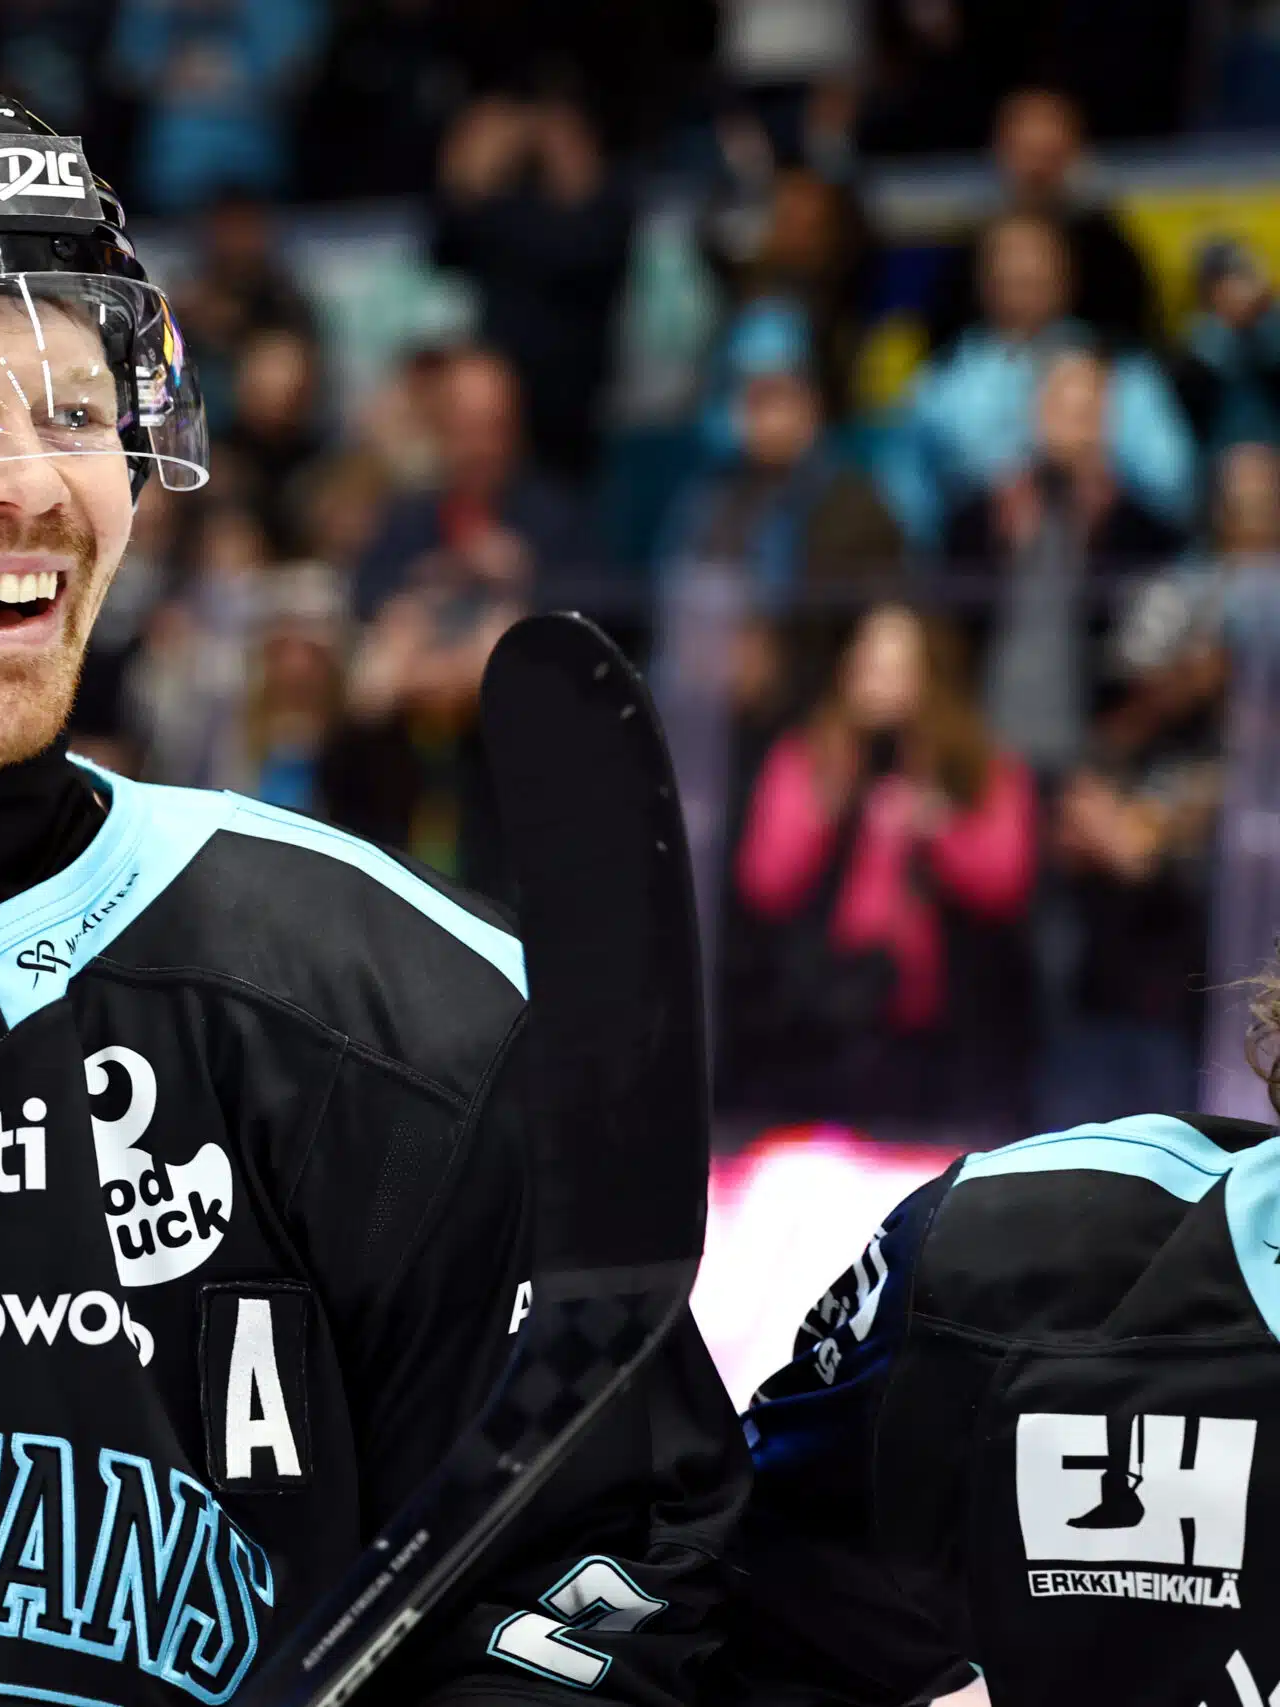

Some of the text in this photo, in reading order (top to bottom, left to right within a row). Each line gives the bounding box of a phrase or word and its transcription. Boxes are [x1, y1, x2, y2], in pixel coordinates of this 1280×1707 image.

[99, 1153, 175, 1217] od
[116, 1191, 229, 1260] uck
[226, 1298, 303, 1480] A
